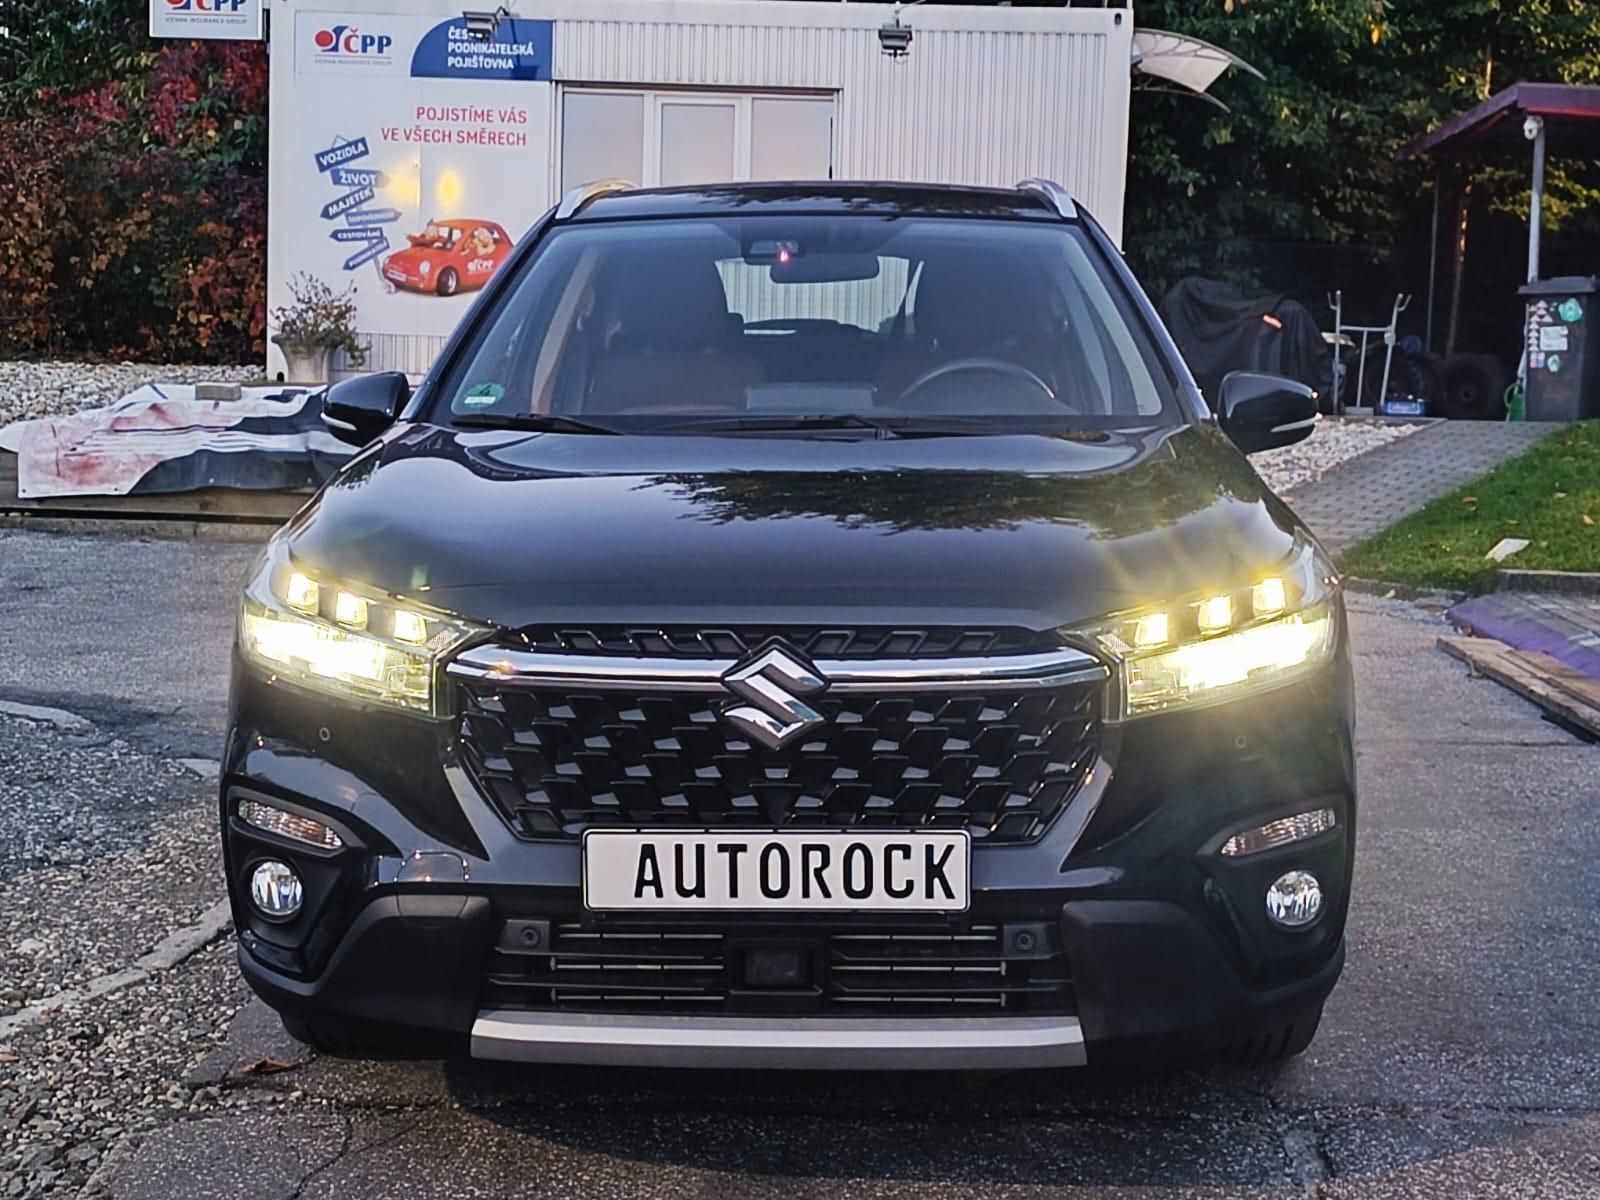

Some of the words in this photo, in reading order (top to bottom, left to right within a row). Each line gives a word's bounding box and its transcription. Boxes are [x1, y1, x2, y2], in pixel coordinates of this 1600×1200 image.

[343, 28, 392, 54] ČPP
[448, 25, 483, 40] ČES
[448, 41, 534, 56] PODNIKATELSKÁ
[447, 54, 514, 69] POJIŠŤOVNA
[416, 104, 494, 123] POJISTÍME
[498, 107, 527, 124] VÁS
[381, 127, 399, 142] VE
[403, 125, 452, 143] VŠECH
[456, 128, 526, 146] SMĚRECH
[319, 142, 366, 167] VOZIDLA
[339, 170, 377, 186] ŽIVOT
[328, 188, 372, 217] MAJETEK
[634, 842, 956, 900] AUTOROCK
